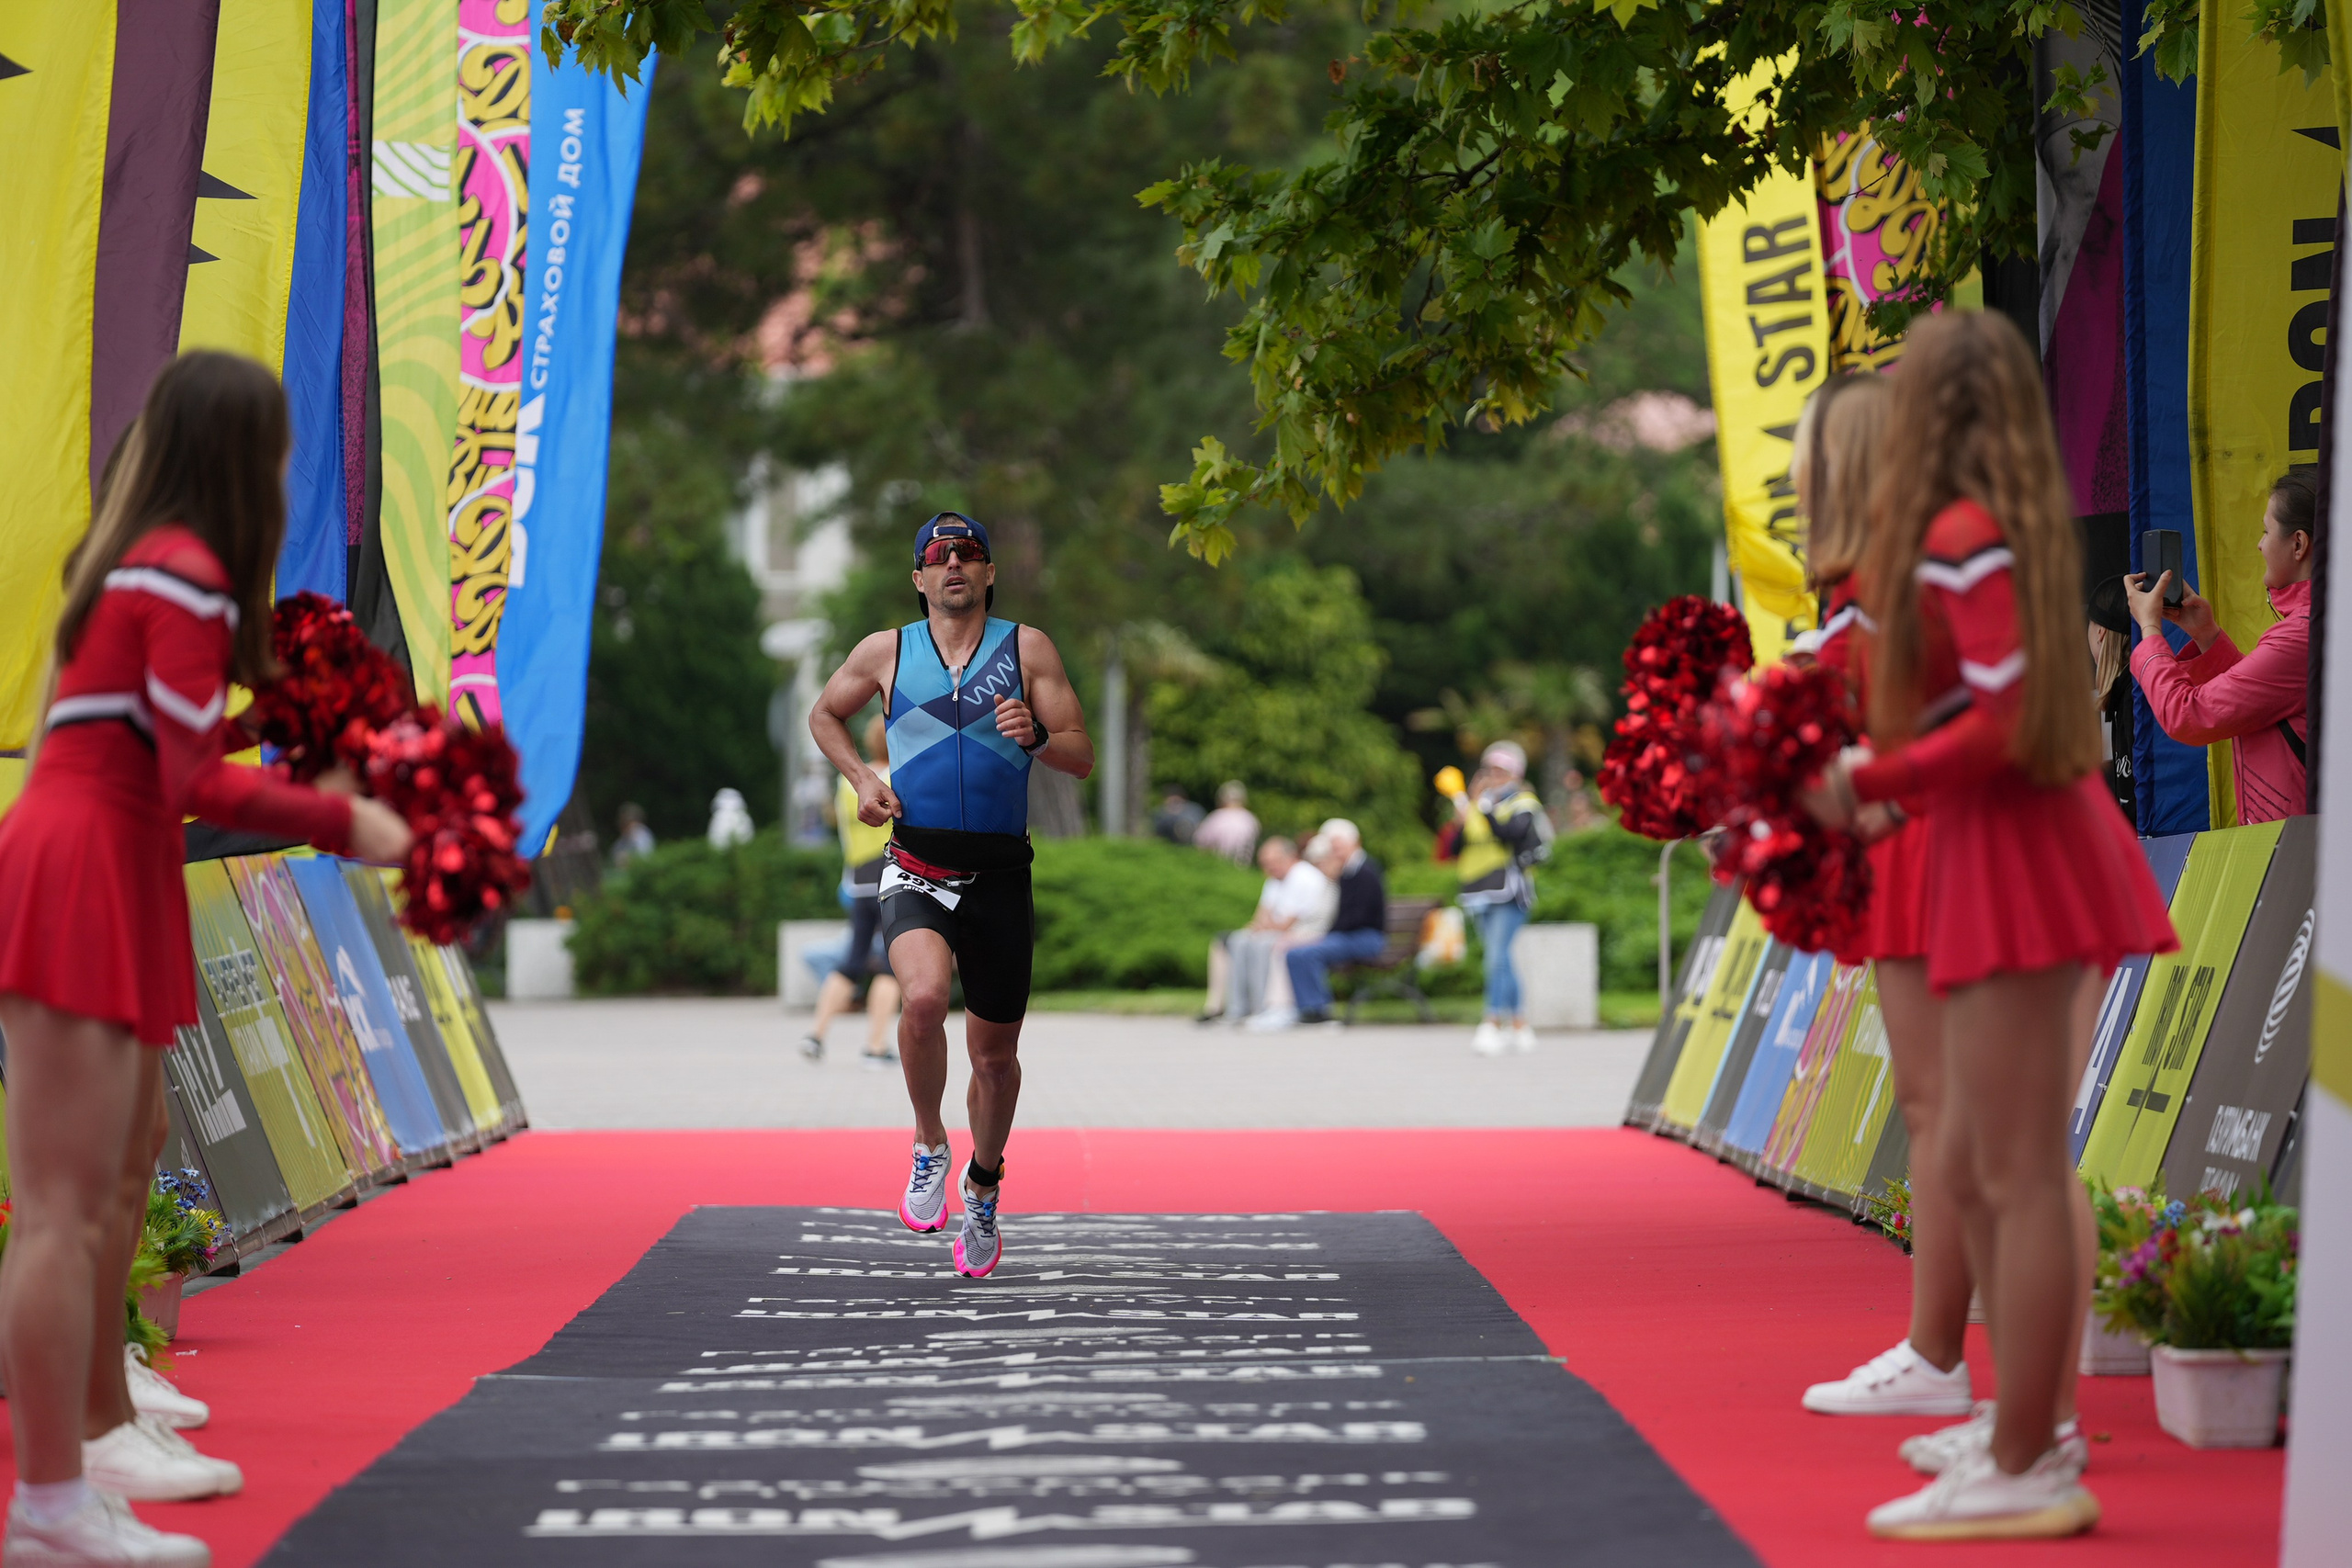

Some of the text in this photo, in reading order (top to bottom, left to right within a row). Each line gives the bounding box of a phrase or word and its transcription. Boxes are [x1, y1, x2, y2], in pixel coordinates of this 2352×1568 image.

[529, 107, 585, 390] СТРАХОВОЙ ДОМ
[1741, 212, 1815, 389] STAR
[897, 872, 938, 893] 497
[902, 885, 924, 894] ARTEM
[739, 1309, 1360, 1320] IRON STAR
